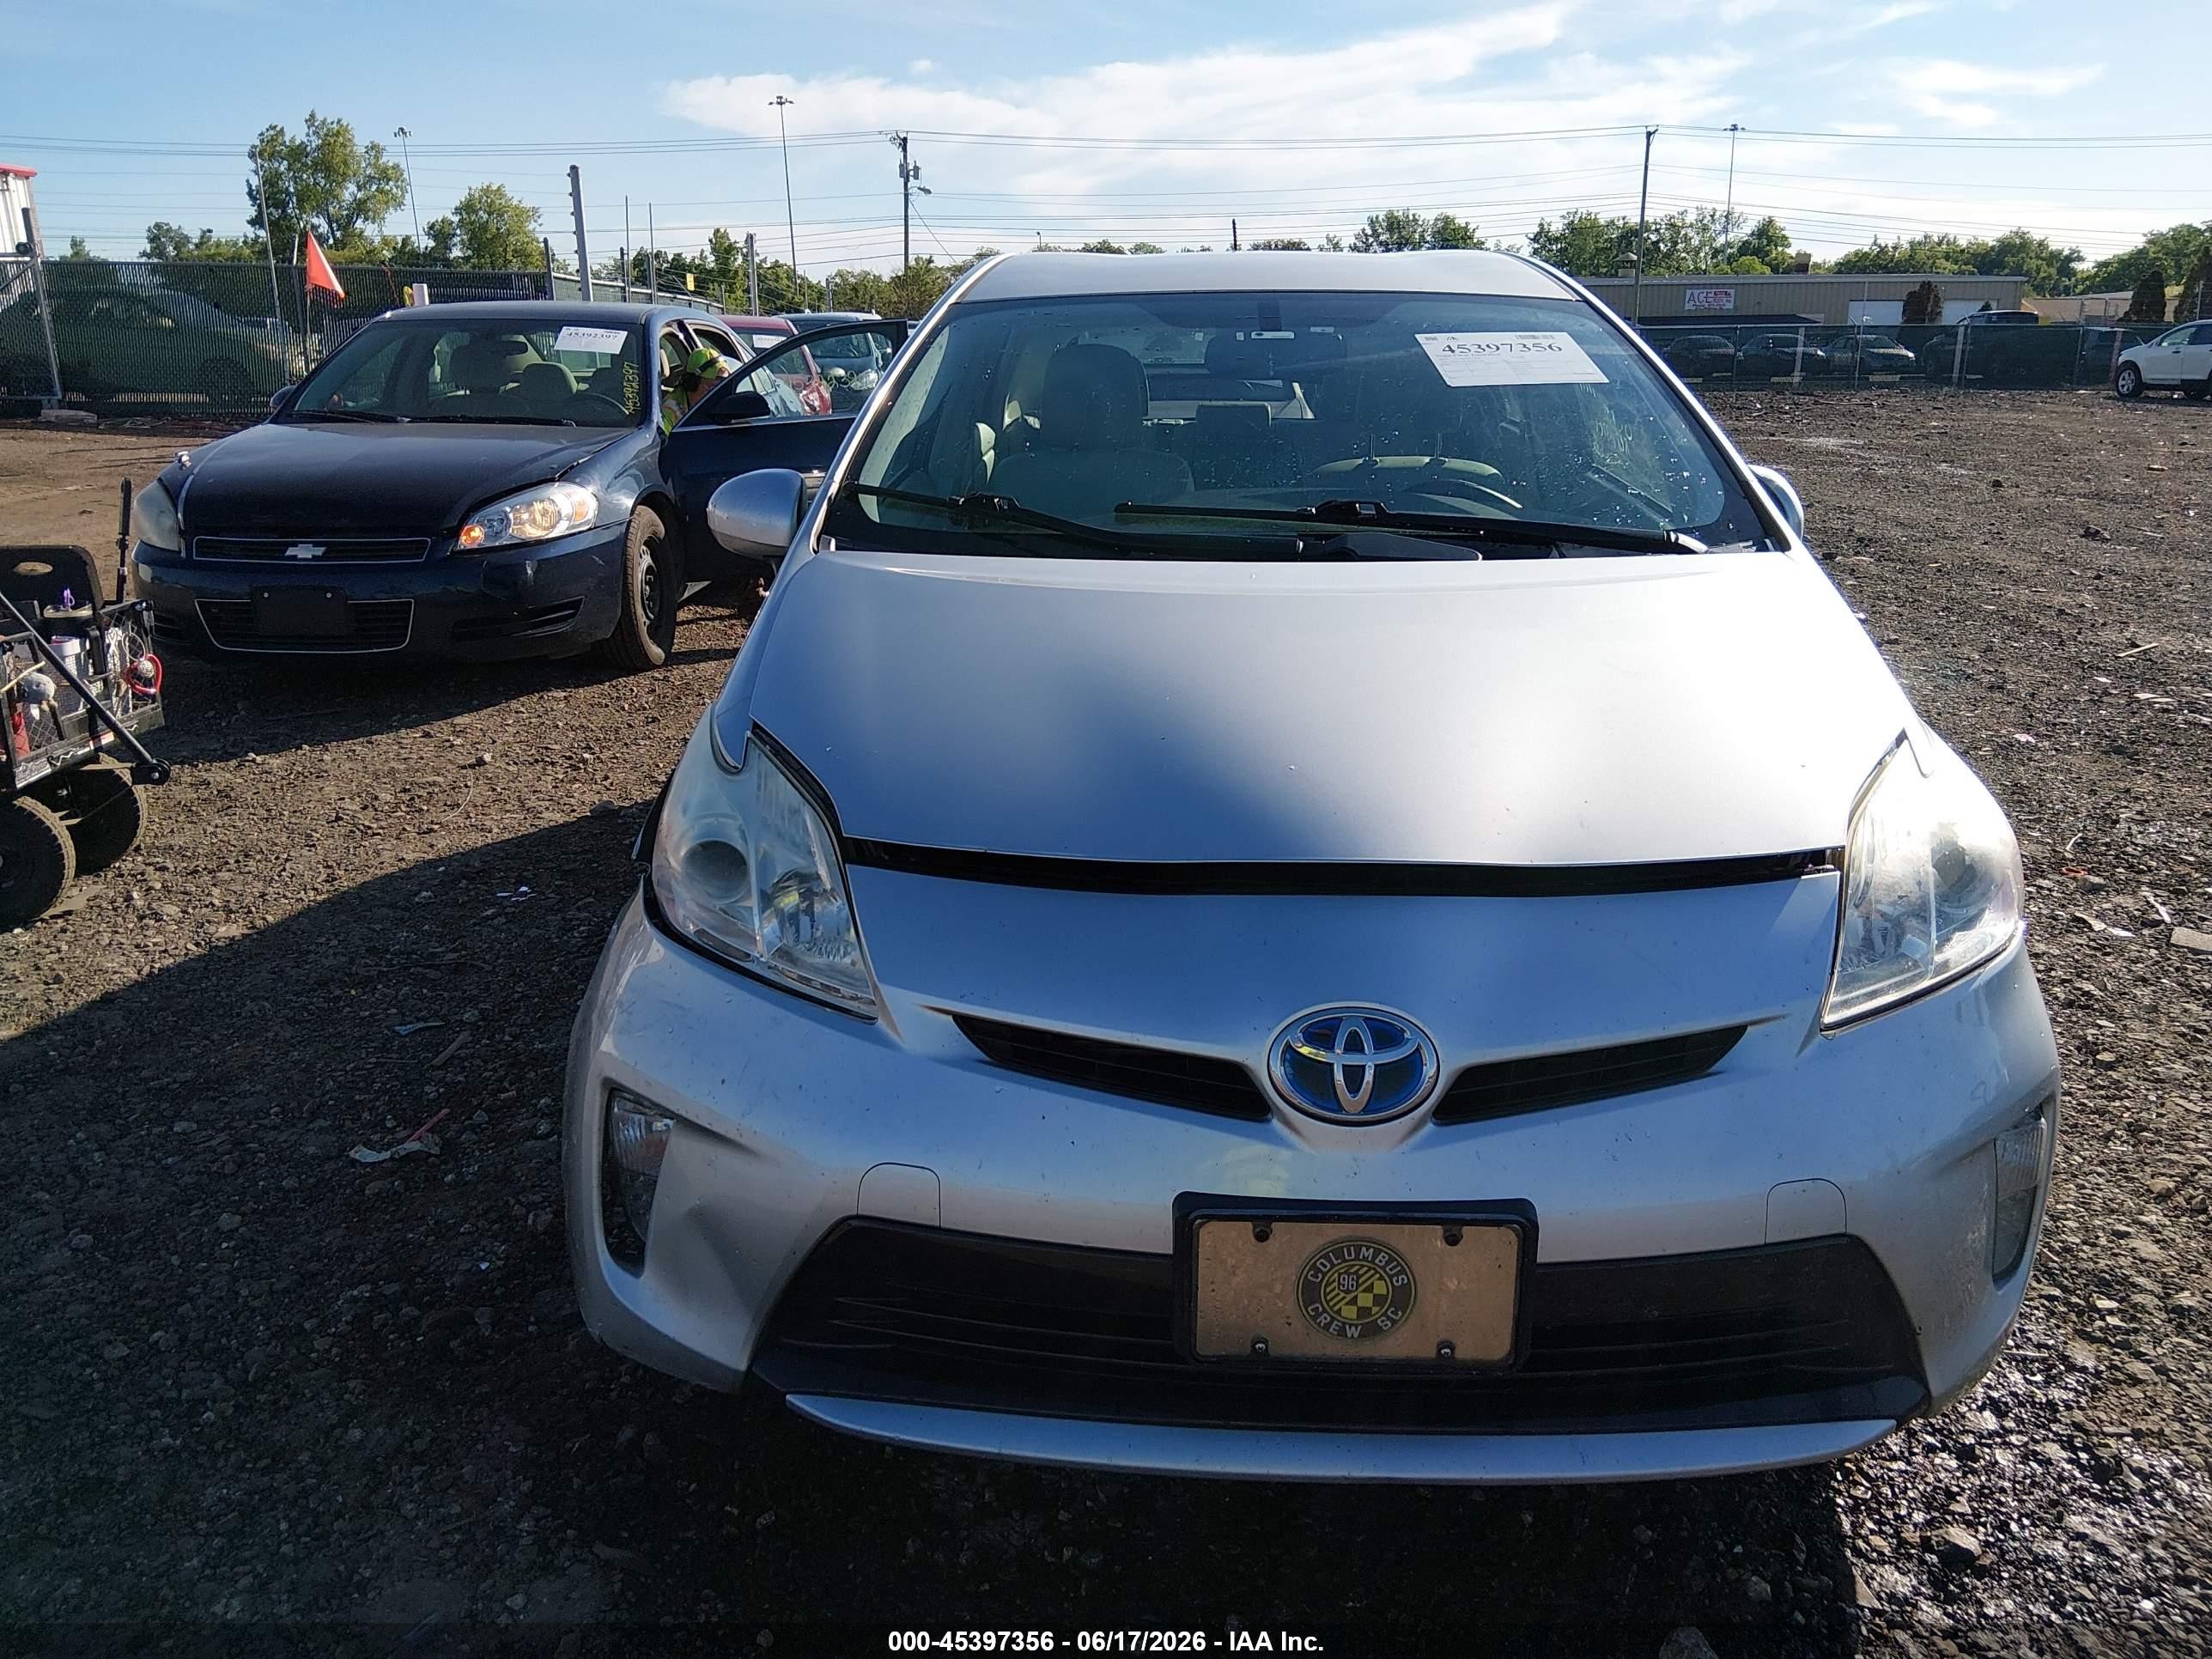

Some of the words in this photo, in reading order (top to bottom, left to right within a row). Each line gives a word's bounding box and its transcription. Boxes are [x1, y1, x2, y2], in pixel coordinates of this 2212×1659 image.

[1686, 290, 1712, 304] ACE
[1442, 342, 1563, 355] 45397356
[1307, 1245, 1408, 1287] COLUMBUS
[1339, 1273, 1357, 1291] 96
[1307, 1303, 1362, 1339] CREW
[1376, 1307, 1402, 1331] SC
